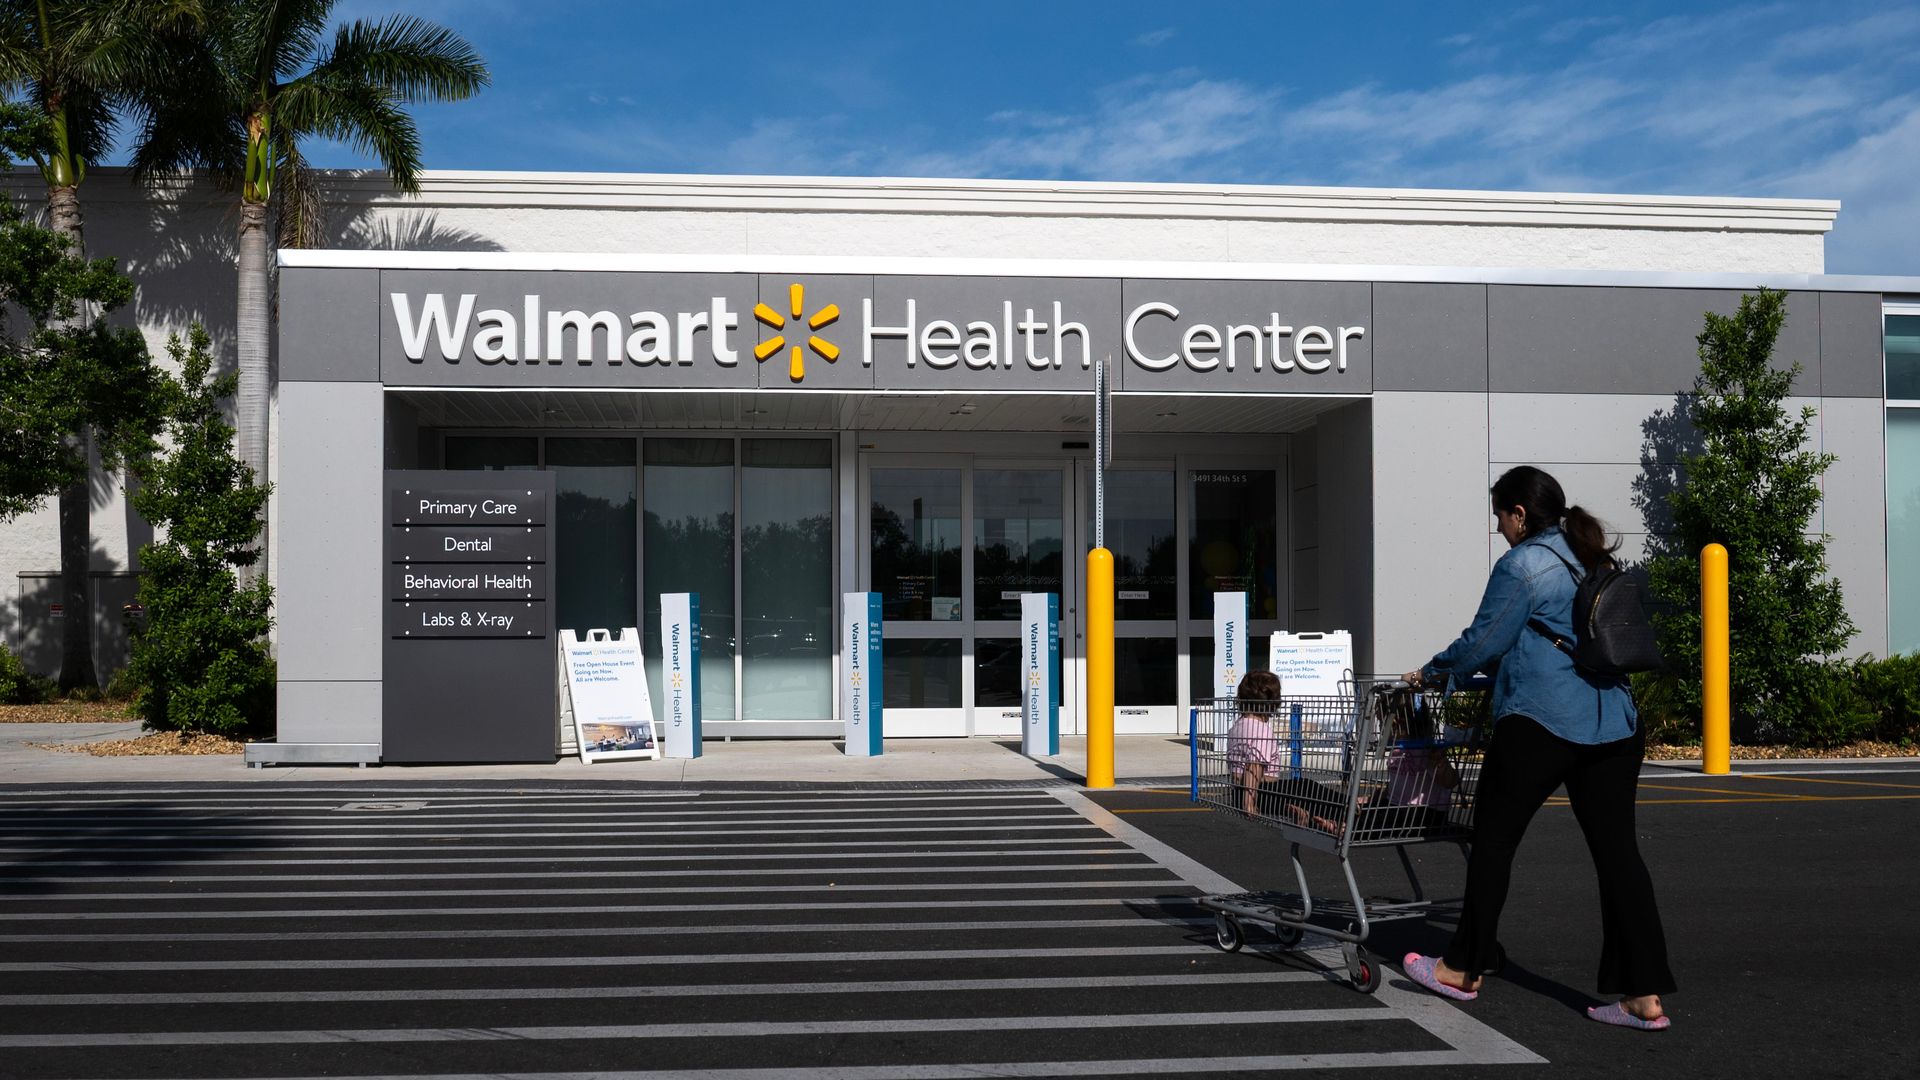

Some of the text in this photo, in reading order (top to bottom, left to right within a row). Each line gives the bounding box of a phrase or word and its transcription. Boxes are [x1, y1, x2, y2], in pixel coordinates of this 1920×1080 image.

[391, 293, 1366, 372] Walmart Health Center
[1191, 474, 1247, 482] 3491 34th St S
[420, 500, 517, 518] Primary Care
[444, 537, 492, 551] Dental
[404, 575, 532, 589] Behavioral Health
[423, 612, 514, 630] Labs & X-ray
[1225, 621, 1234, 667] Walmart
[671, 623, 682, 727] Walmart Health
[852, 622, 861, 725] Walmart Health
[1031, 623, 1040, 725] Walmart Health
